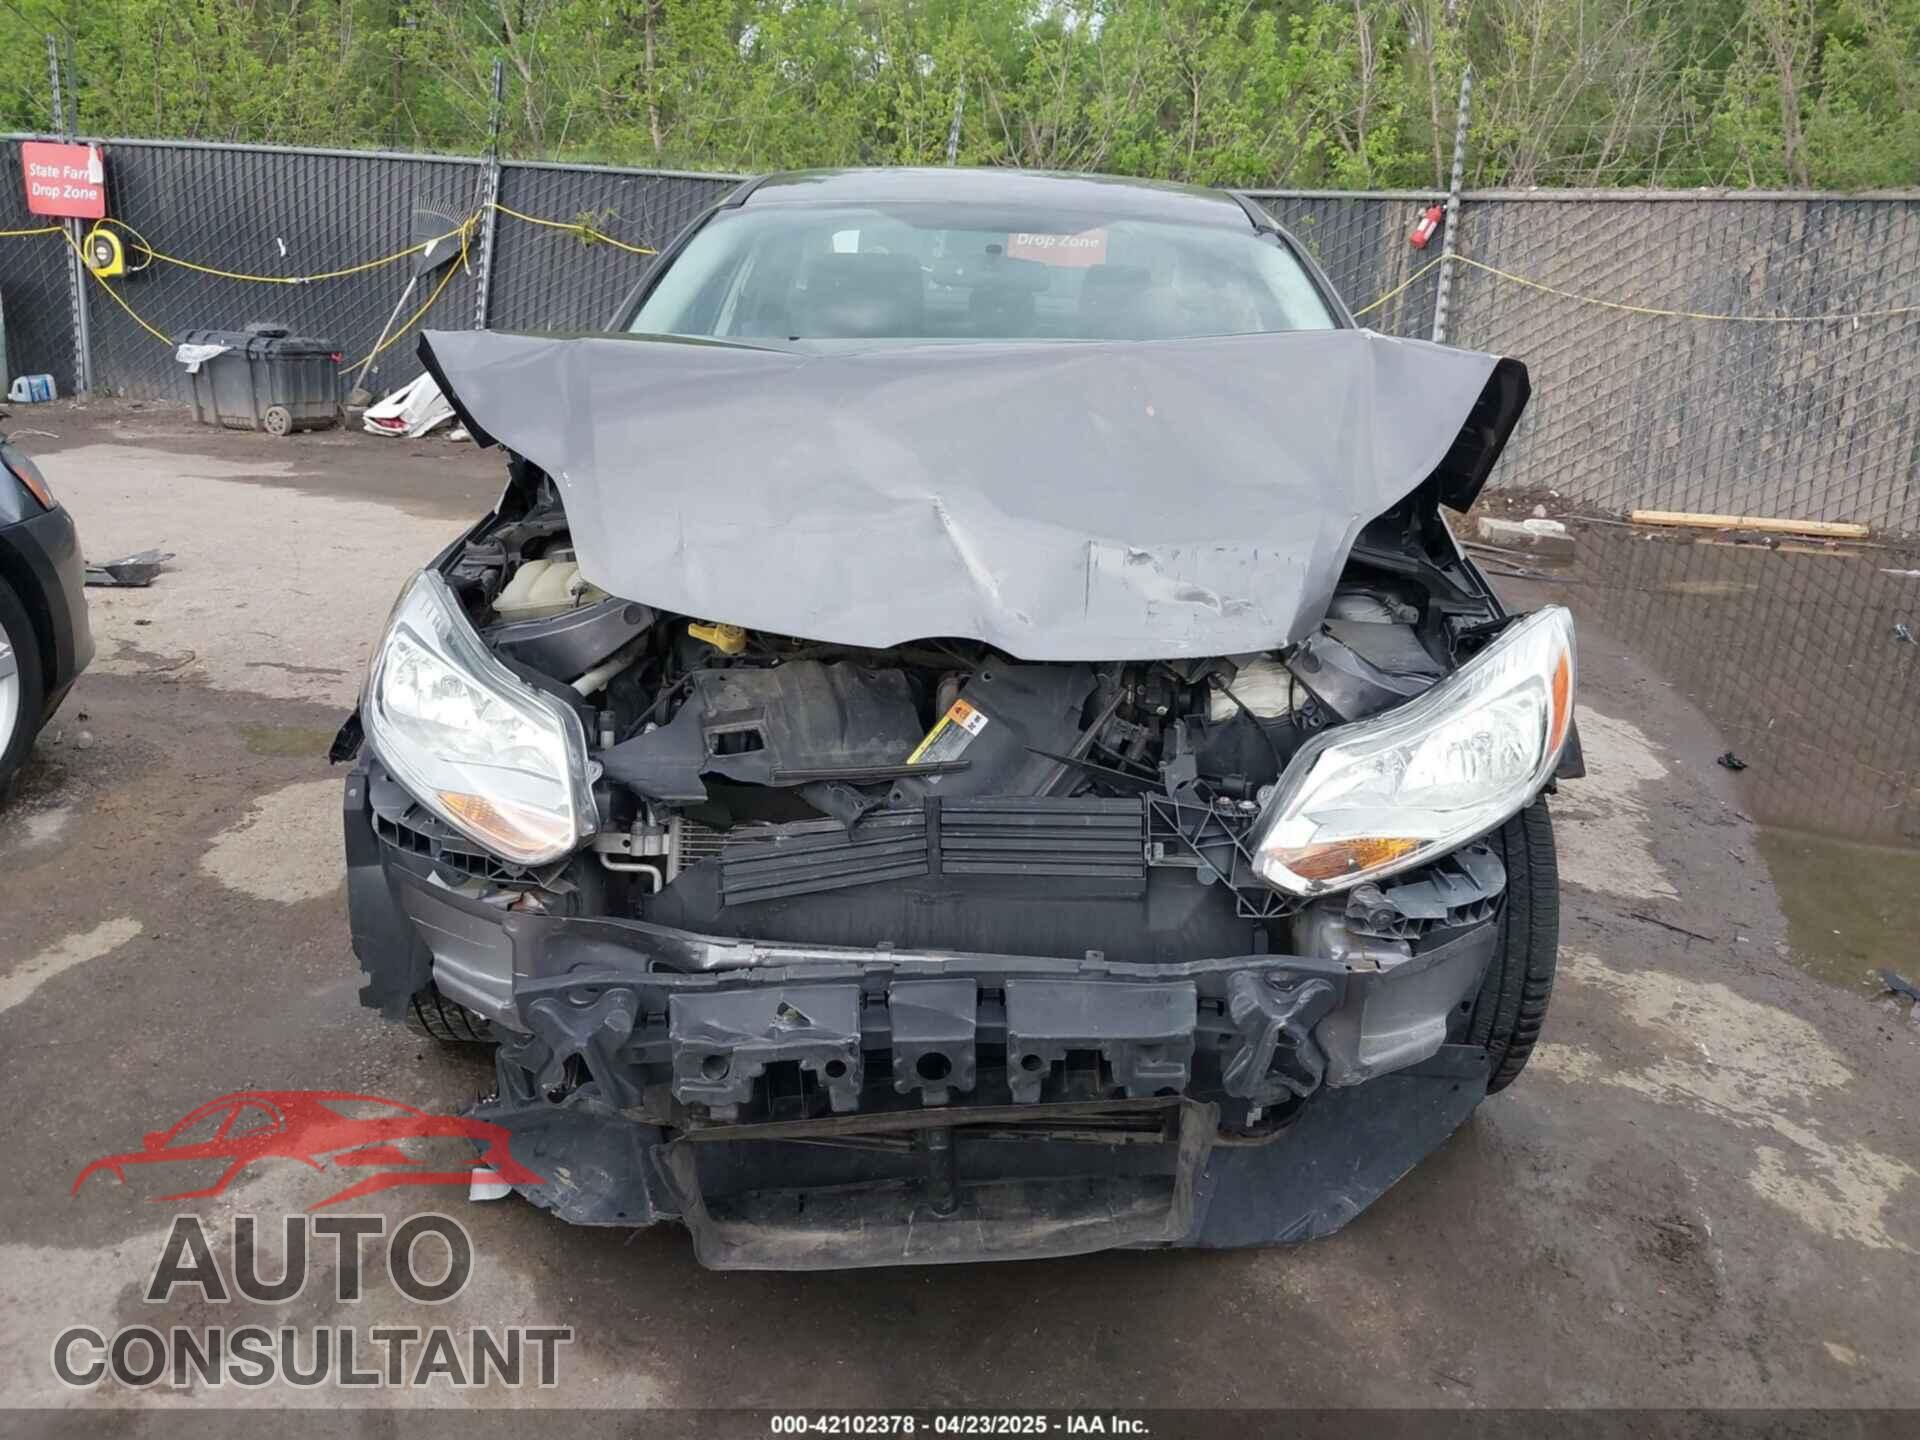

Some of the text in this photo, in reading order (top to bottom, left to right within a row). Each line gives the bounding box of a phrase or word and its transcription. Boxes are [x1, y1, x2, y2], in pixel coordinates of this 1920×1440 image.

[29, 163, 60, 178] State
[32, 182, 97, 200] Drop Zone
[1017, 232, 1099, 249] Drop Zone
